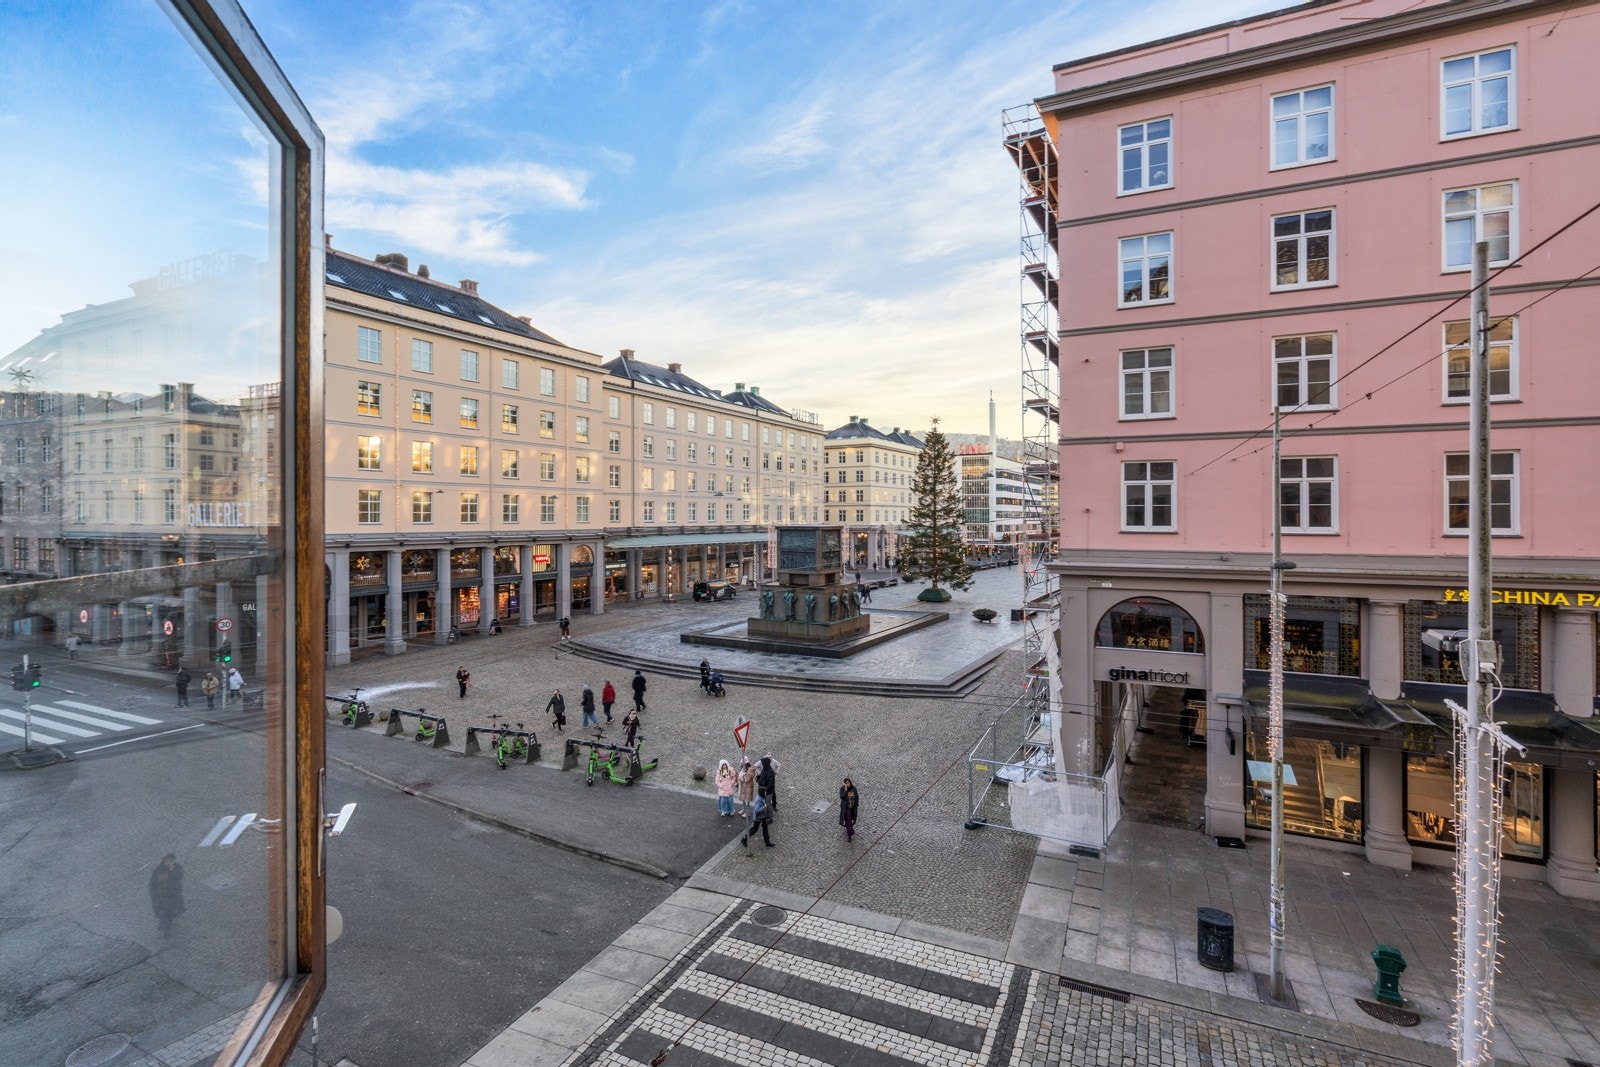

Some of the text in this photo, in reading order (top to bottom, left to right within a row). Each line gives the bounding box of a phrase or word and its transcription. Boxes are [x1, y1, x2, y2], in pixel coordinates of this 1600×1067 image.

[188, 502, 251, 527] GALLERIET
[1491, 590, 1571, 607] CHINA
[220, 620, 231, 629] 30
[1298, 649, 1336, 657] PALACE
[1108, 666, 1190, 685] ginatricot
